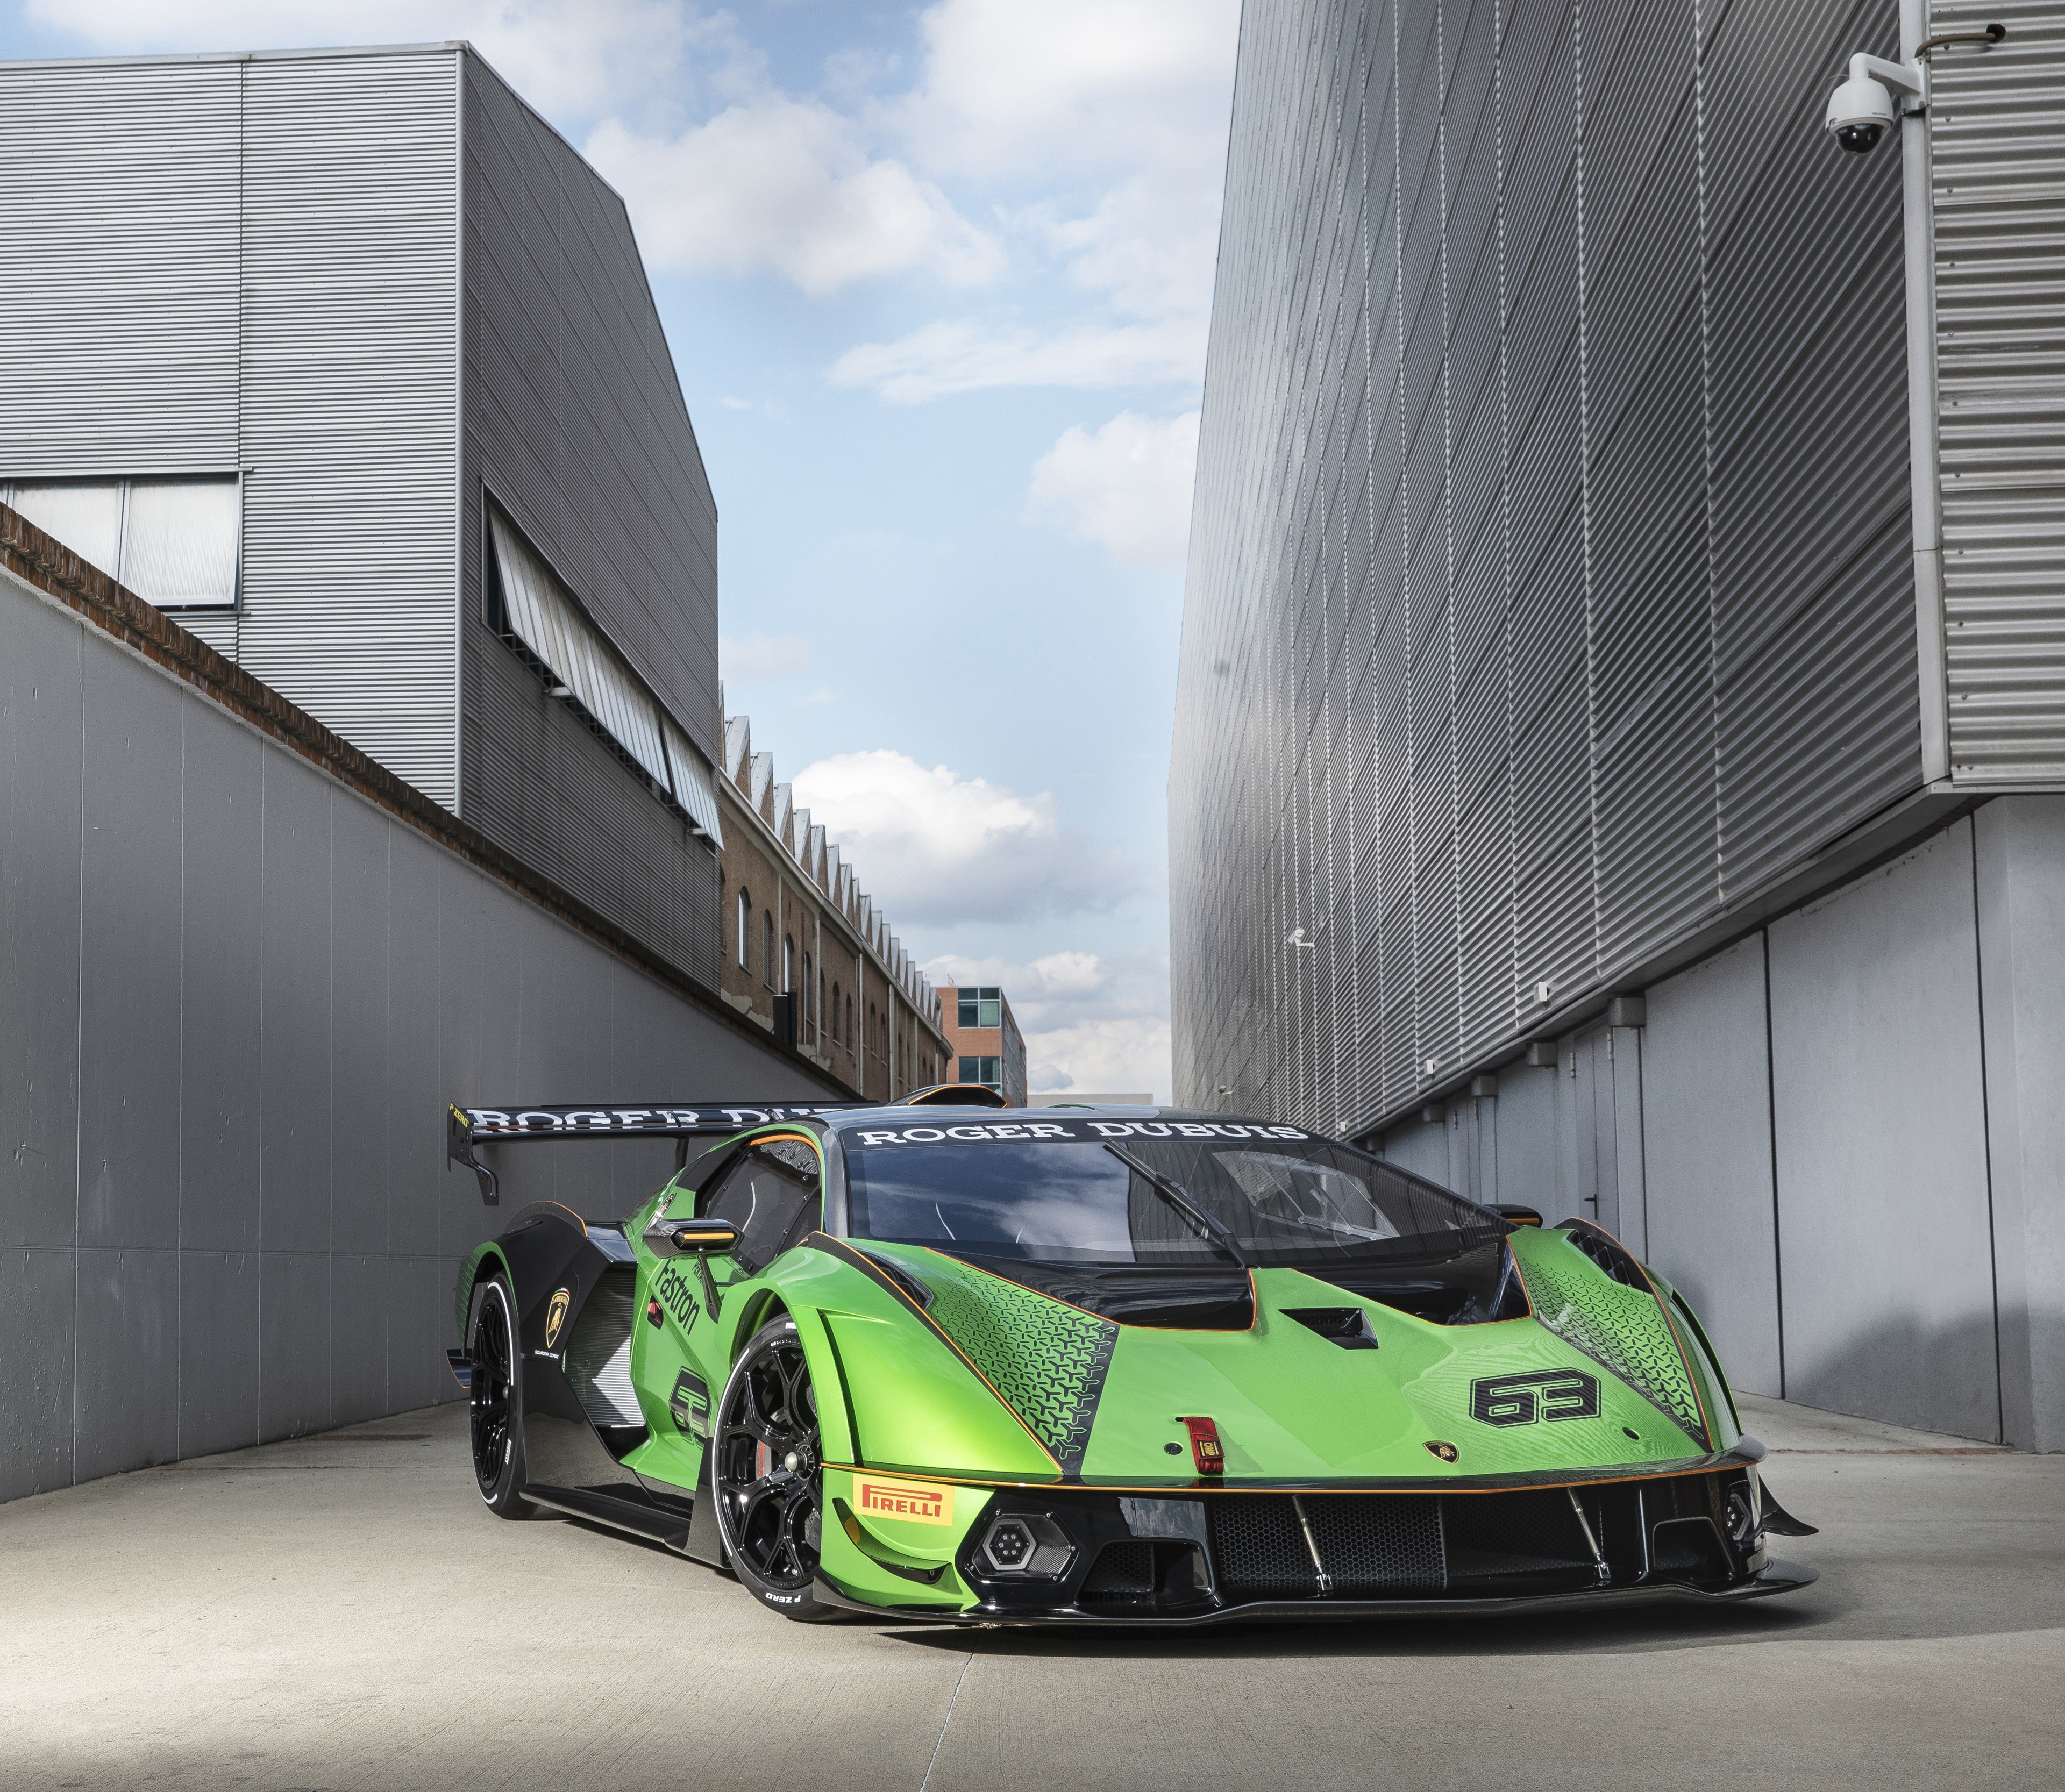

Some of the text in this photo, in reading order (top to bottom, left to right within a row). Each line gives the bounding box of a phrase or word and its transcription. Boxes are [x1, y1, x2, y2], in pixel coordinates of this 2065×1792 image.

[450, 1103, 467, 1127] P ZERO
[467, 1109, 700, 1133] ROGER
[857, 1123, 1308, 1145] ROGER DUBUIS
[655, 1259, 700, 1336] Fastron
[1469, 1367, 1601, 1429] 63
[1204, 1442, 1215, 1455] OMP
[862, 1484, 943, 1517] PIRELLI
[766, 1593, 801, 1603] P ZERO
